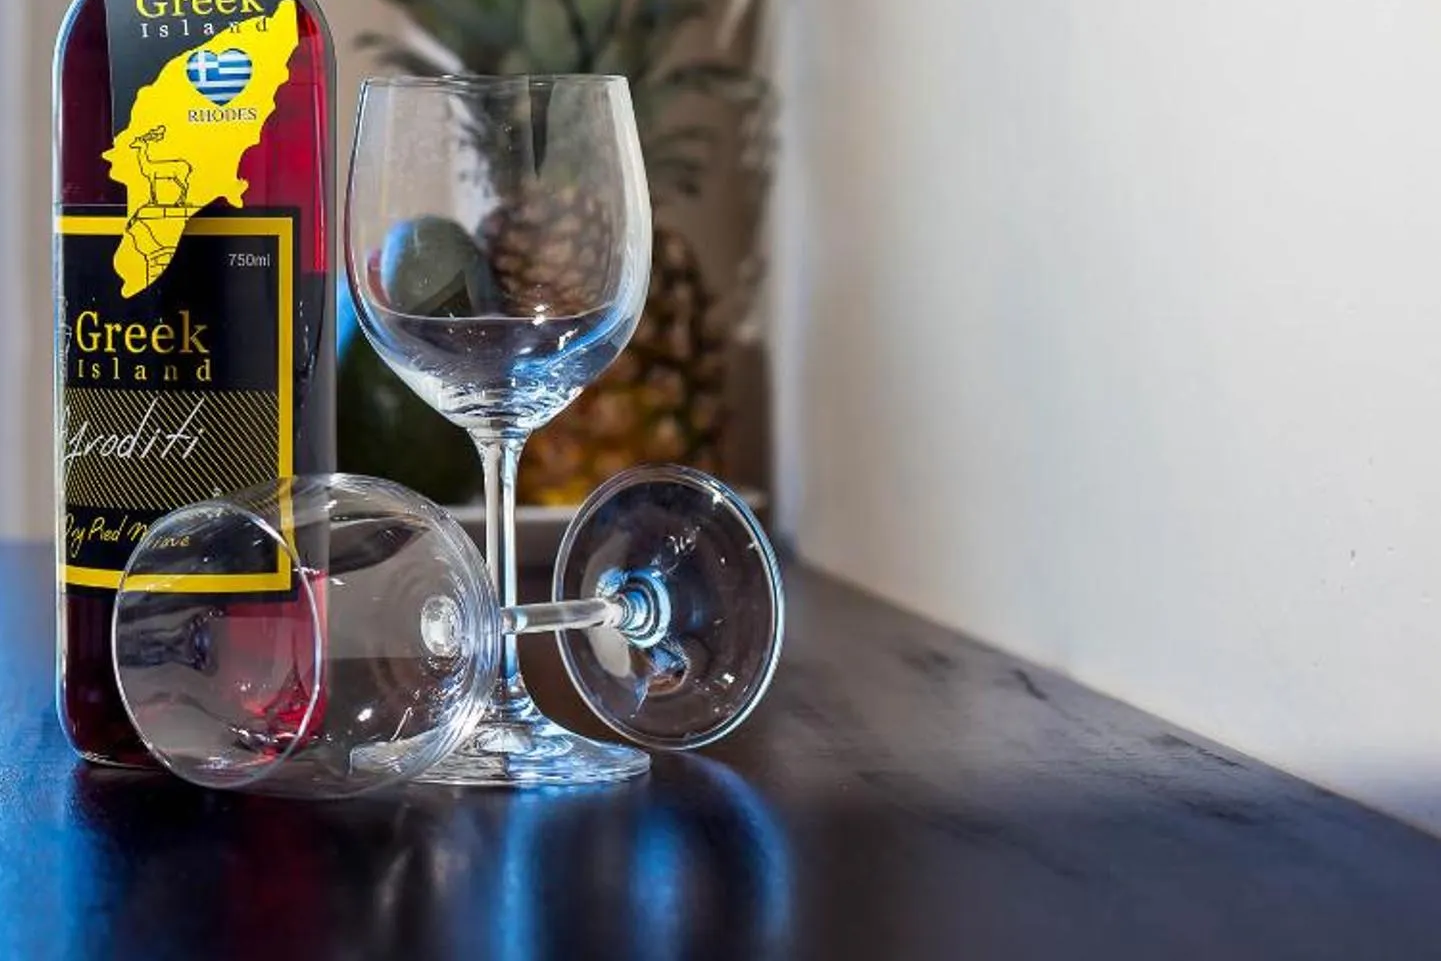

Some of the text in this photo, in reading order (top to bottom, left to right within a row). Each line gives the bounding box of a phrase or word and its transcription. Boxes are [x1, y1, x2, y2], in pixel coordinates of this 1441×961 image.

[140, 15, 269, 38] Island
[188, 108, 257, 122] RHODES
[228, 253, 270, 267] 750ml
[76, 310, 210, 353] Greek
[78, 357, 212, 381] Island
